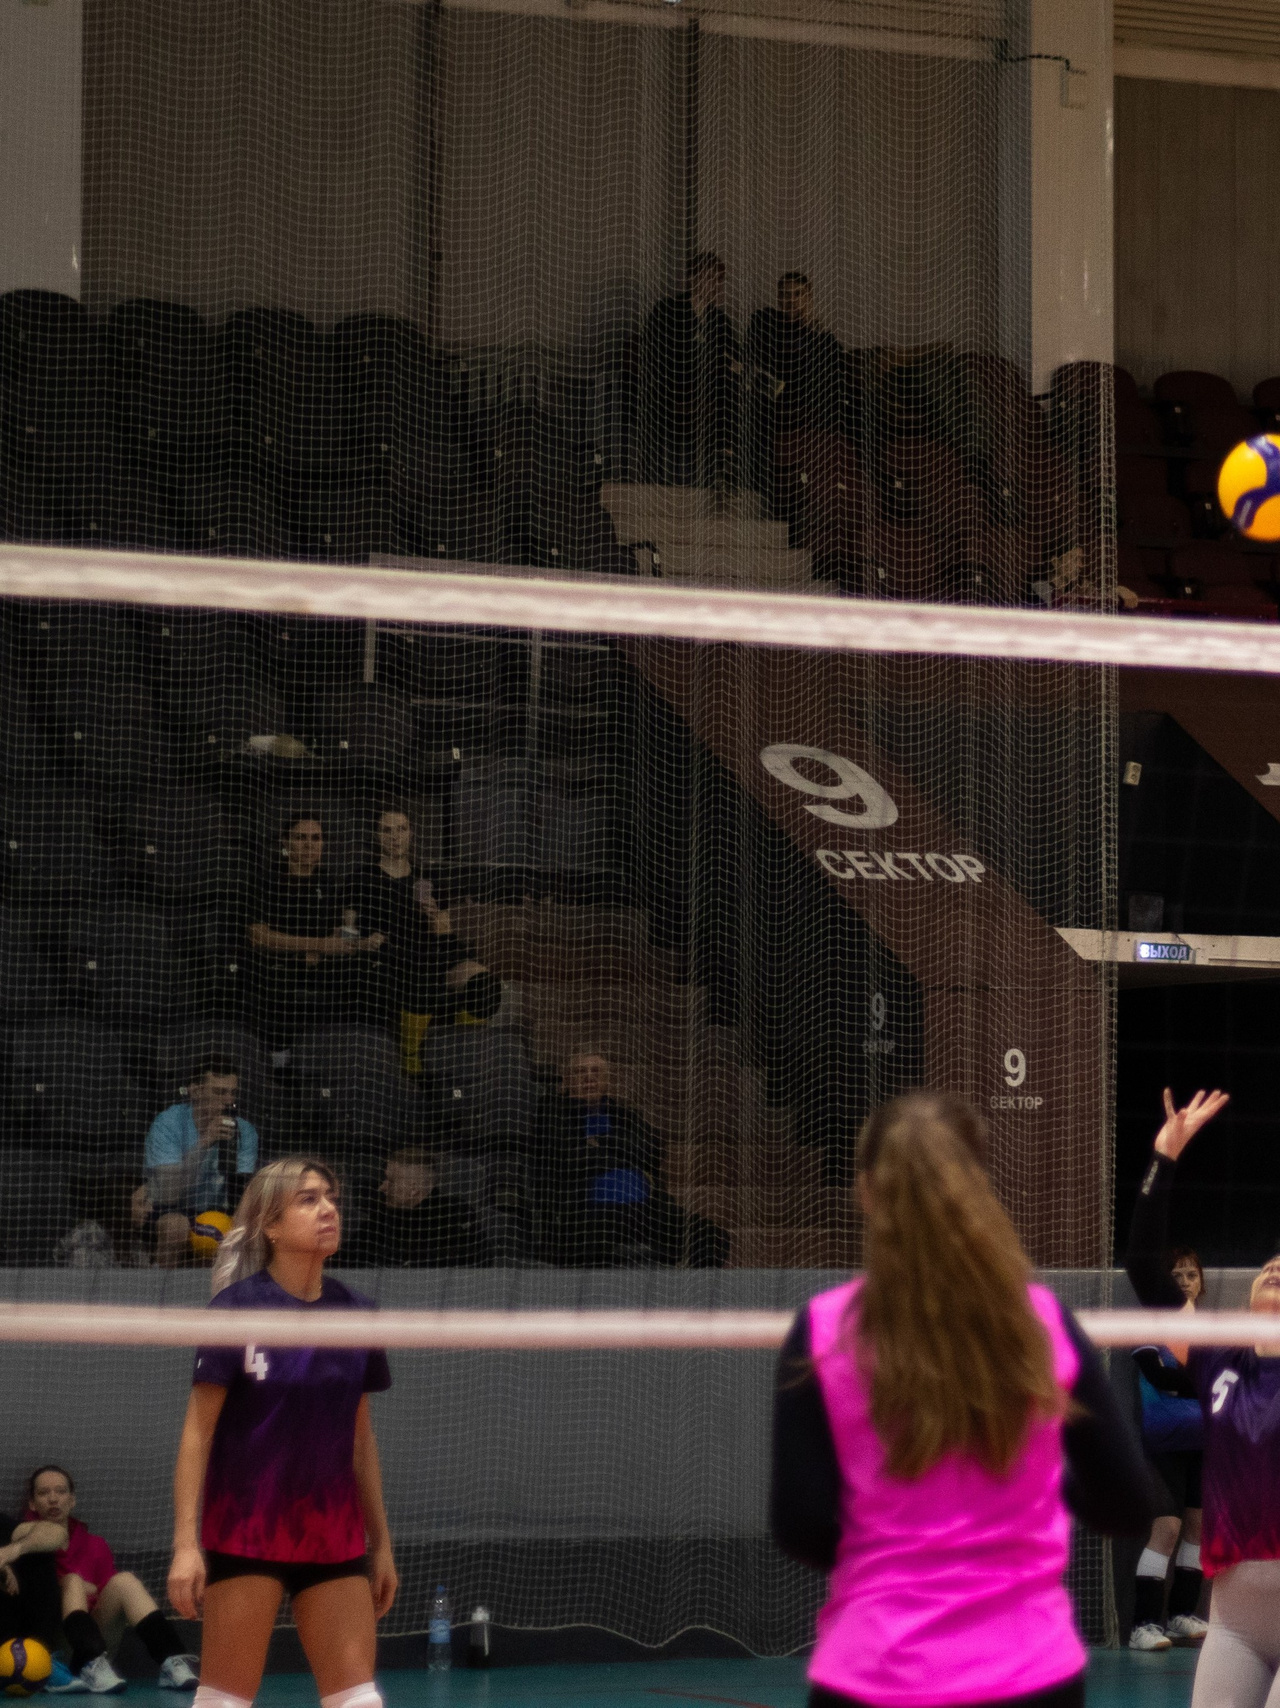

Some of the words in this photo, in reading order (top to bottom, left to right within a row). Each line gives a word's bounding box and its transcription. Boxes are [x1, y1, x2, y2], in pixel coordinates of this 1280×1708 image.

[760, 744, 898, 829] 9
[815, 850, 986, 883] СЕКТОР
[1140, 943, 1188, 960] ВЫХОД
[871, 992, 885, 1031] 9
[1004, 1048, 1026, 1087] 9
[990, 1096, 1044, 1110] СЕКТОР
[244, 1342, 269, 1381] 4
[1211, 1369, 1240, 1414] 5
